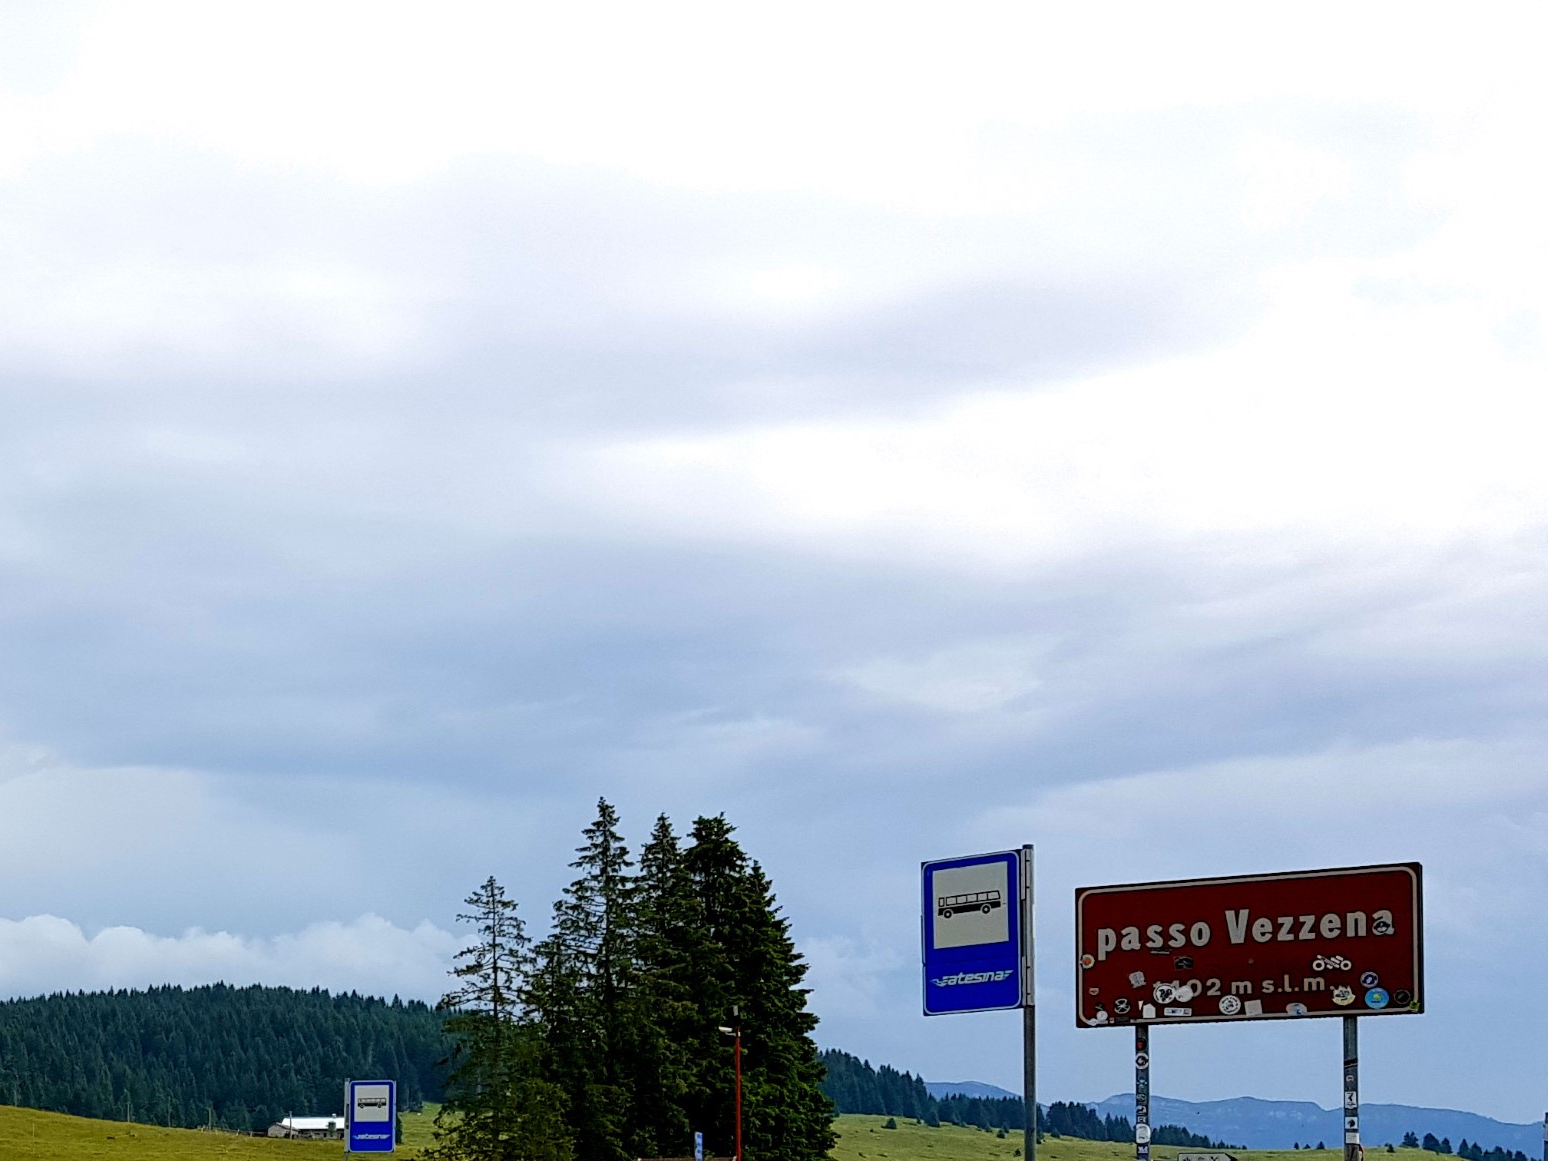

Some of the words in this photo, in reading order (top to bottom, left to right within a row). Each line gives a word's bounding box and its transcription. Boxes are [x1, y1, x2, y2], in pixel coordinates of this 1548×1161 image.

[1097, 921, 1211, 961] passo
[1224, 909, 1395, 944] Vezzena
[941, 970, 1008, 986] atesina
[1231, 980, 1252, 995] m
